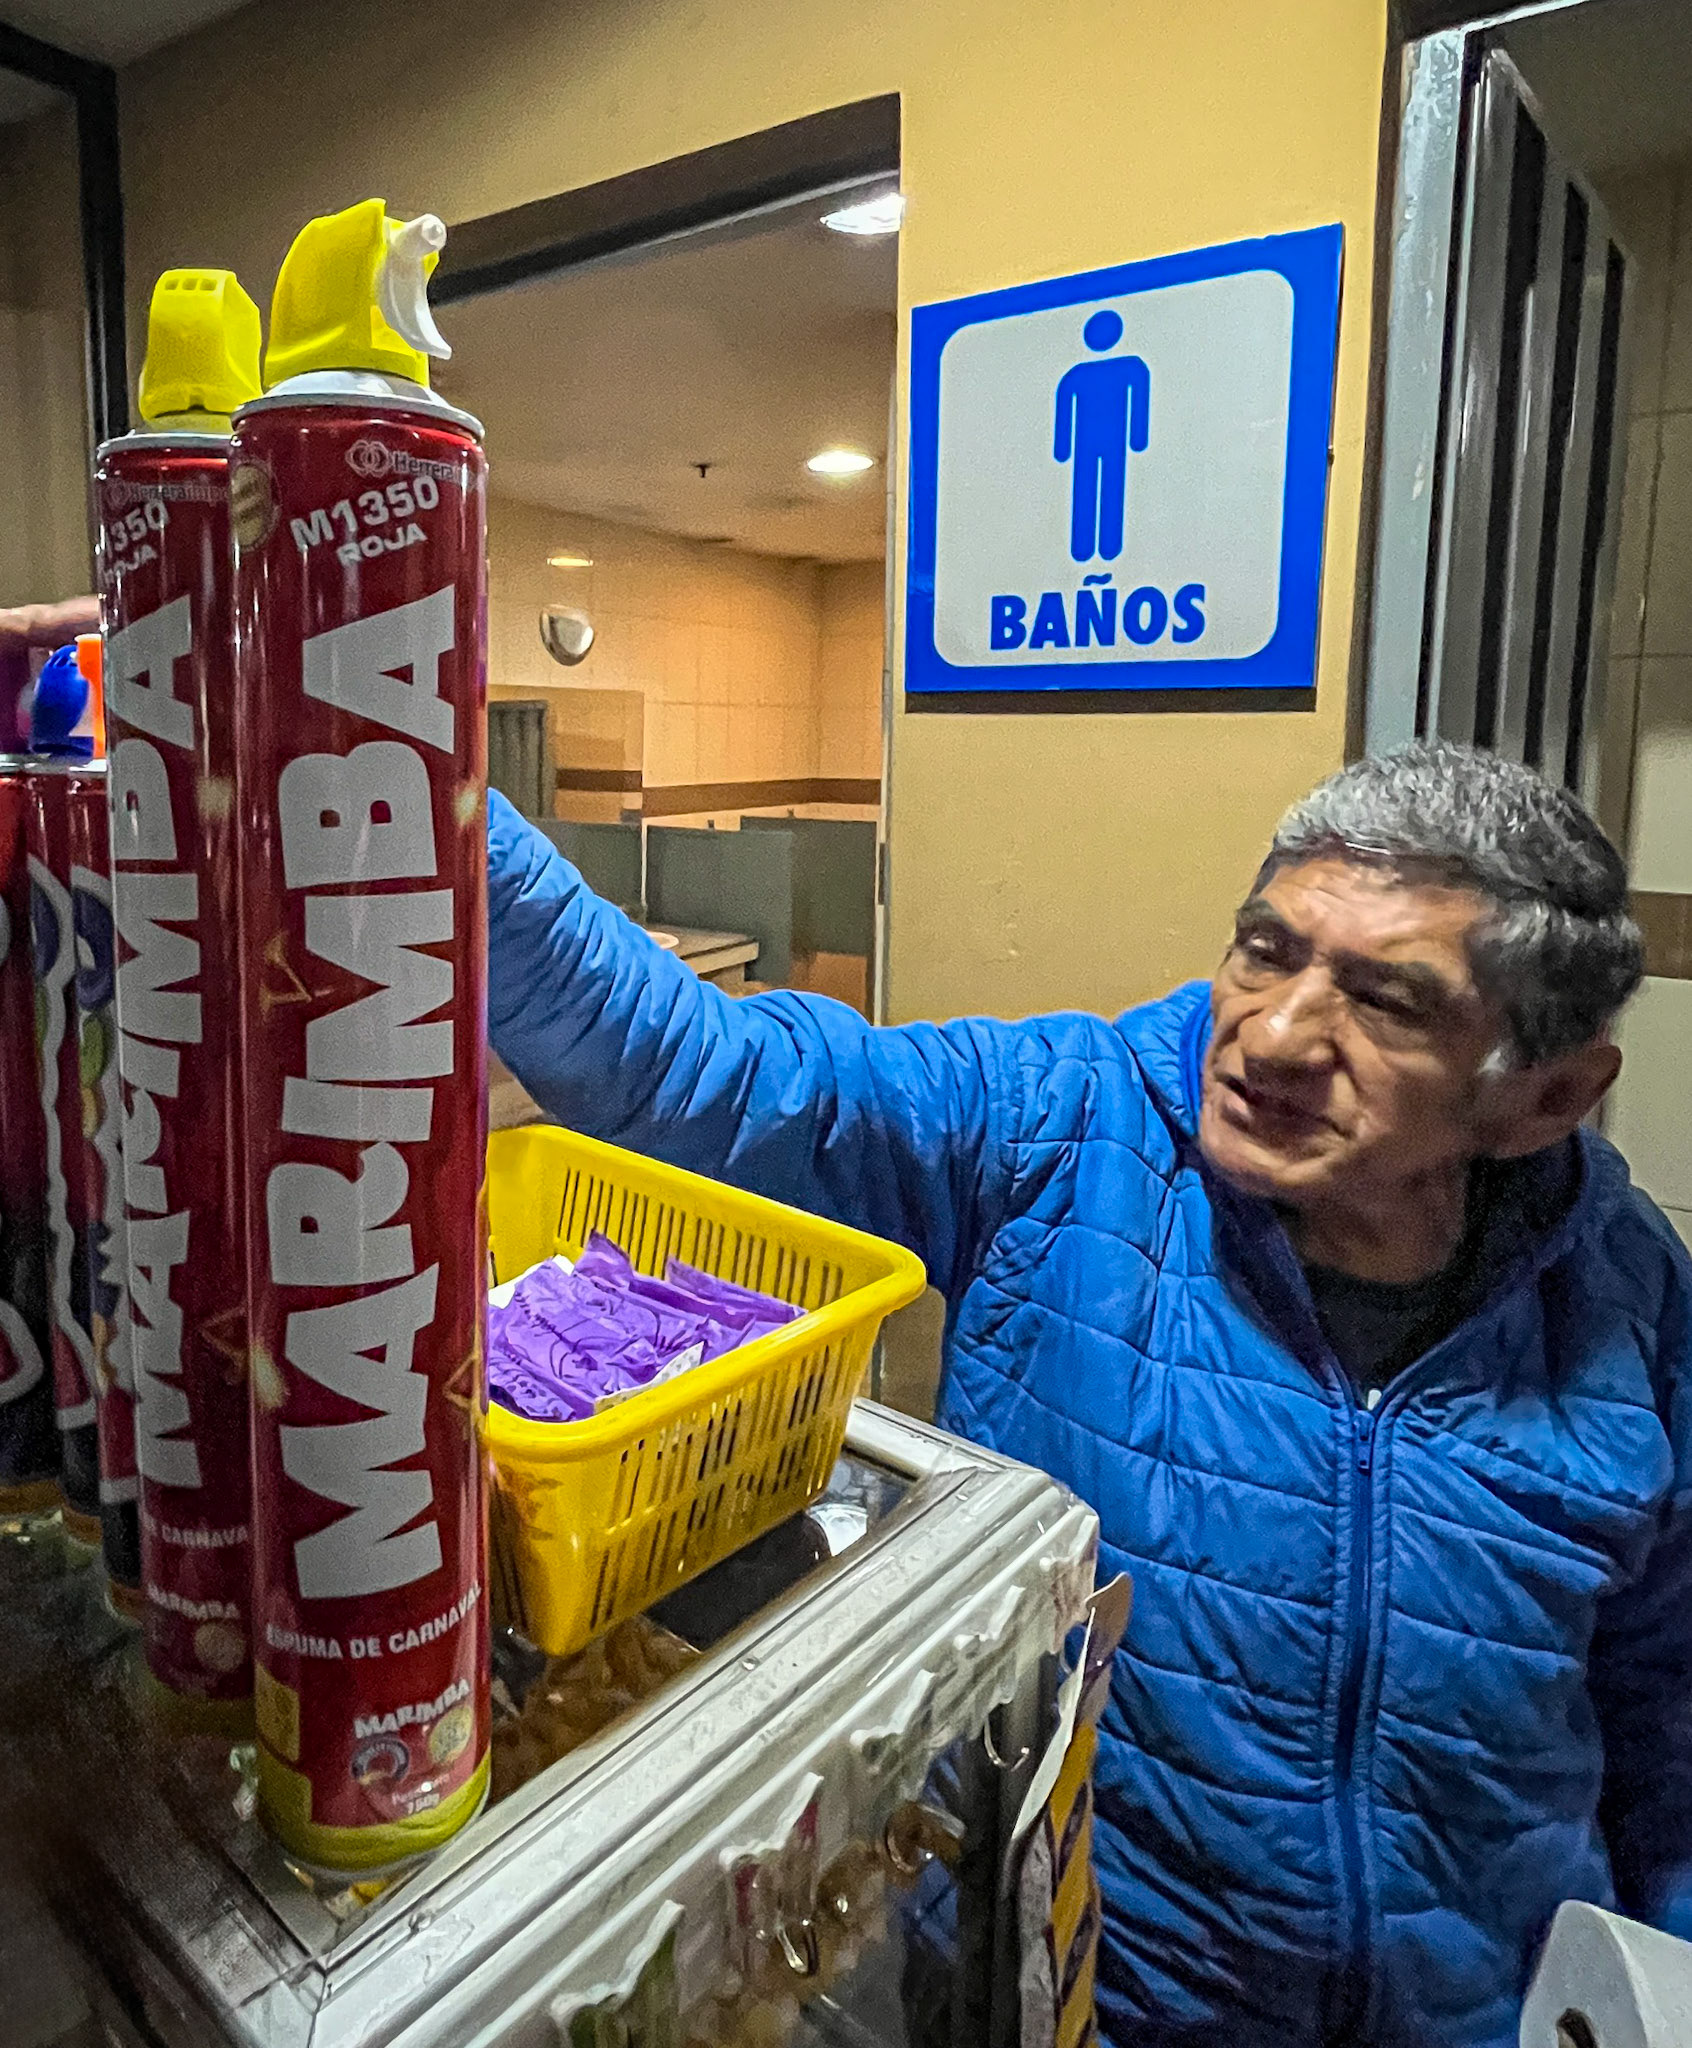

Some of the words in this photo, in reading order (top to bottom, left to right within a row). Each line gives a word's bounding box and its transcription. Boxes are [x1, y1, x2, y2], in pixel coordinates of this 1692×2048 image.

[289, 473, 440, 553] M1350
[336, 522, 428, 568] ROJA
[990, 572, 1206, 650] BAÑOS
[266, 583, 456, 1600] MARIMBA
[350, 1637, 383, 1660] DE
[353, 1678, 471, 1740] MARIMBA
